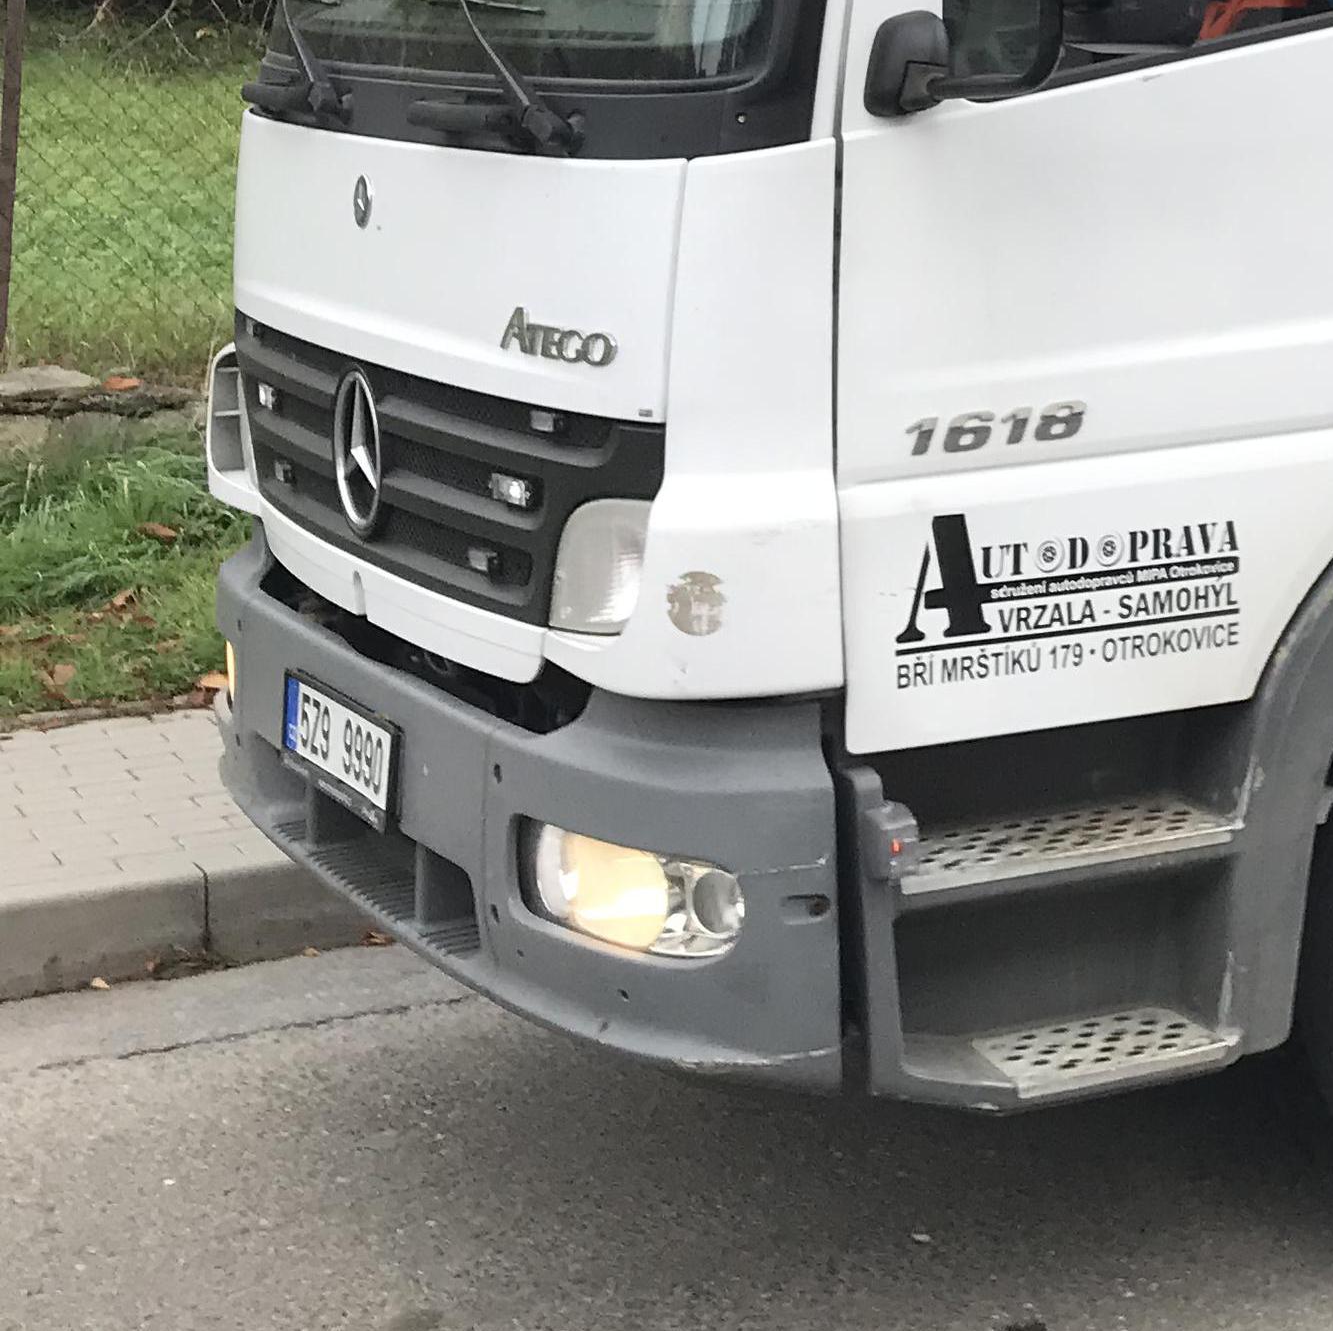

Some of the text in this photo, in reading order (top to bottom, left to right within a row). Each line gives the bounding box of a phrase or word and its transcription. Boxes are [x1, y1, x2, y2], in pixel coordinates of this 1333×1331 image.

[905, 400, 1087, 456] 1618
[998, 599, 1097, 633] VRZALA
[1118, 574, 1238, 619] SAMOHÝL
[1049, 642, 1083, 670] 179
[1101, 622, 1240, 663] OTROKOVICE
[301, 693, 383, 795] 5Z9 9990
